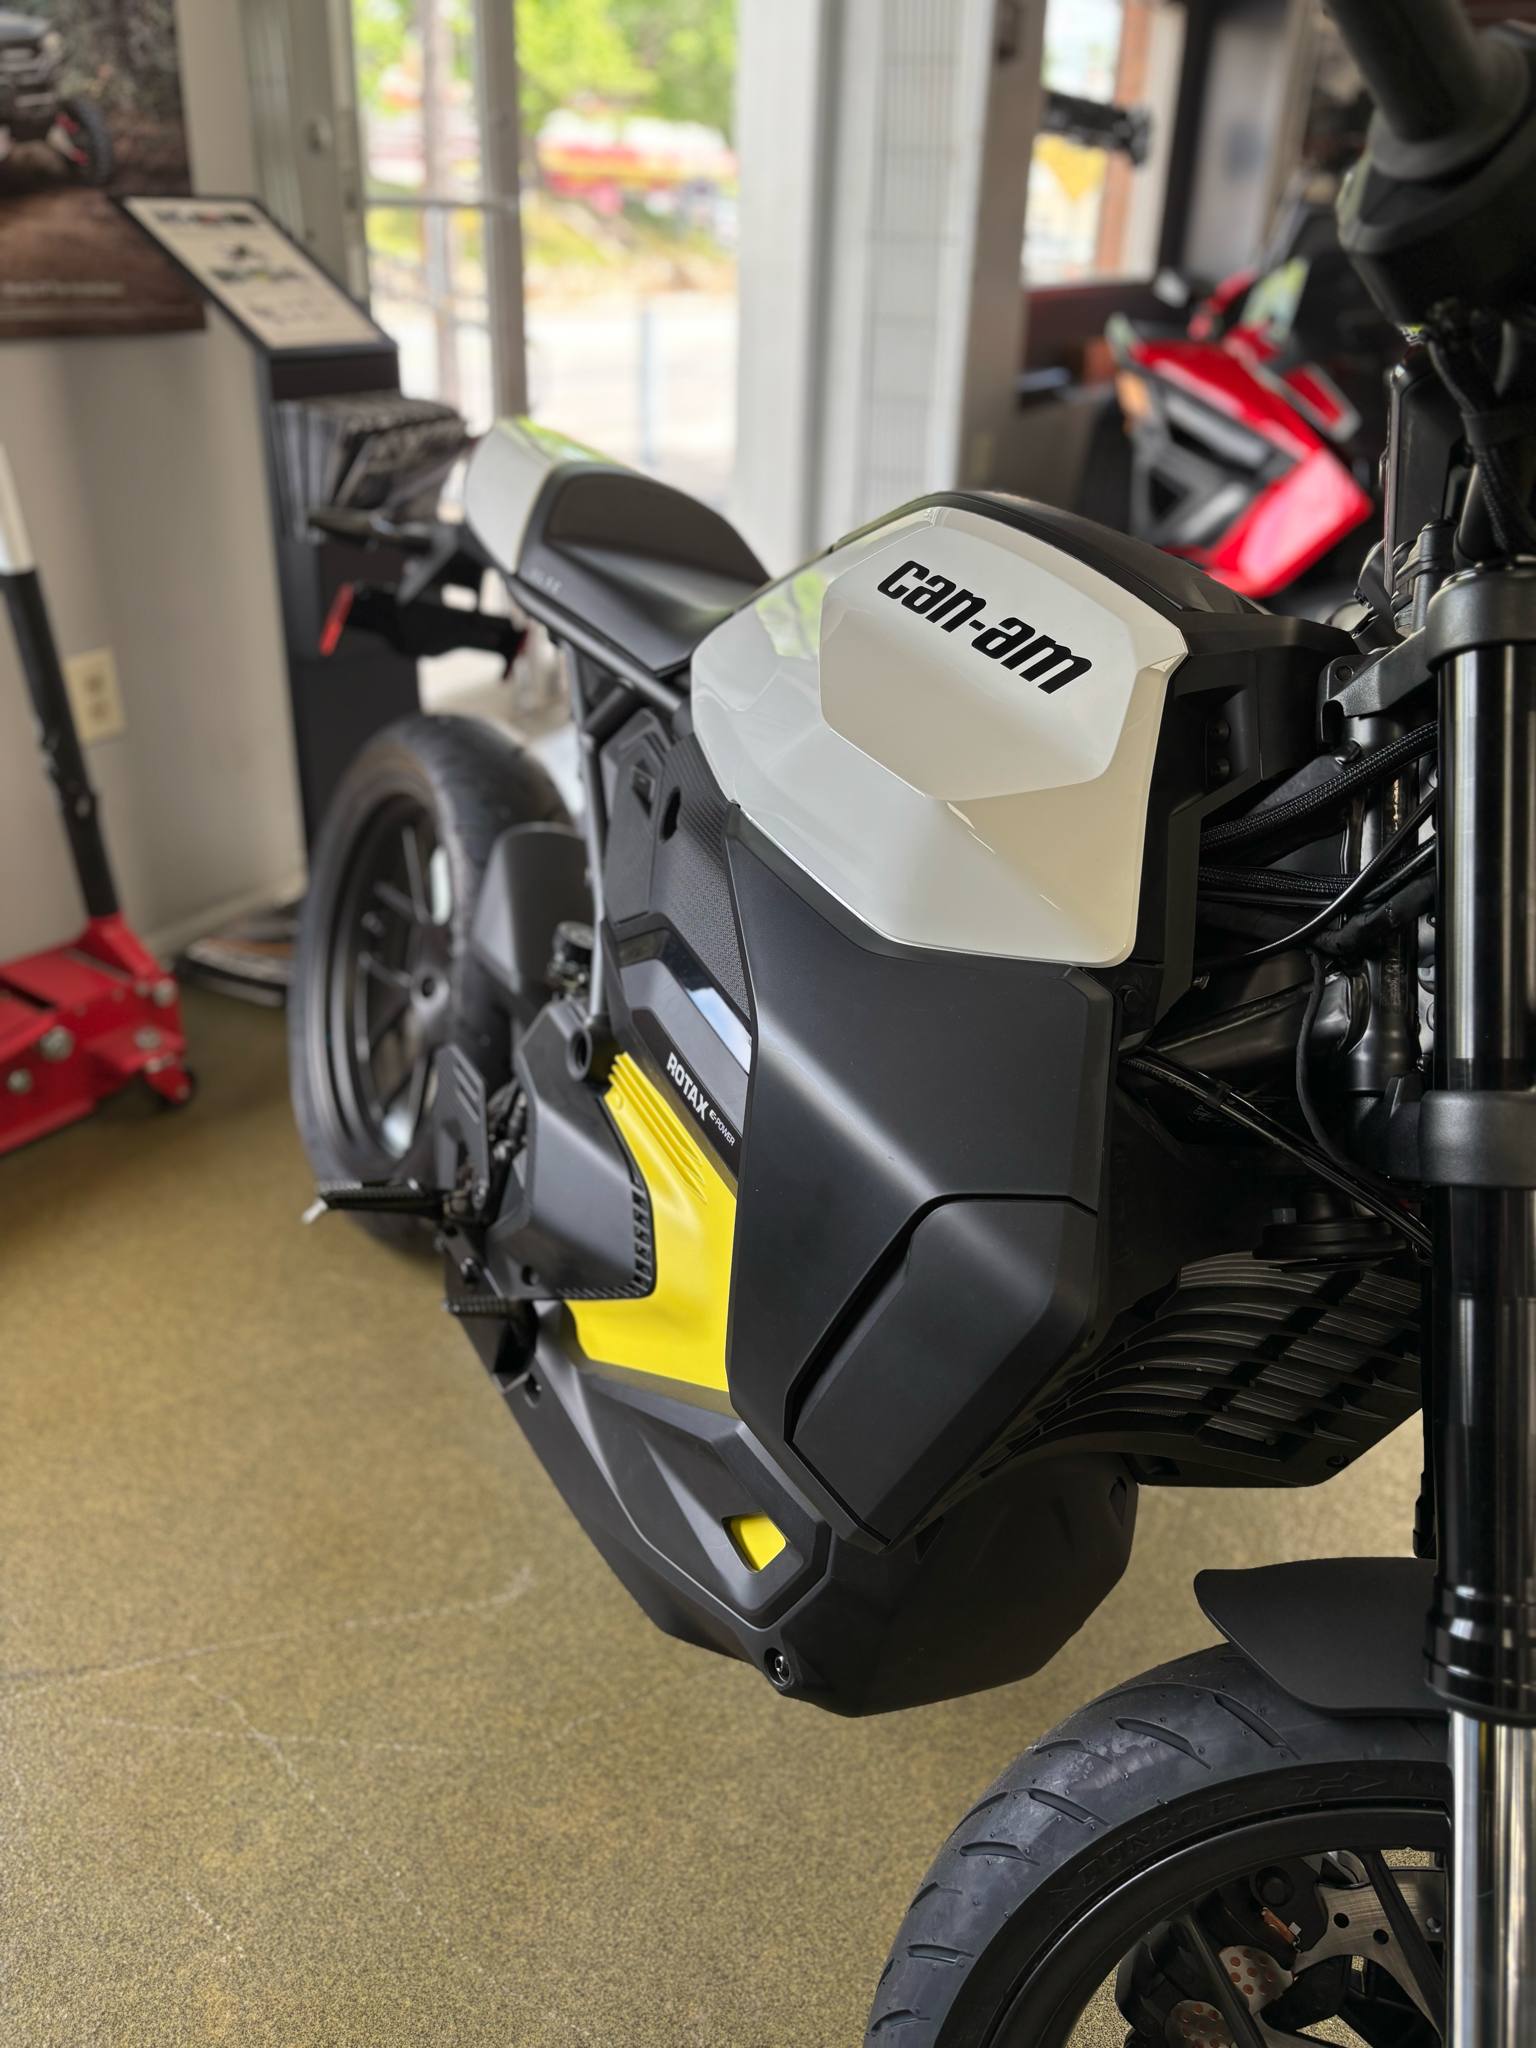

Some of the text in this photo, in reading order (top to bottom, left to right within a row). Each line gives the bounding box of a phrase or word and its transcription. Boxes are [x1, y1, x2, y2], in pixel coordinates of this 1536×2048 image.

[877, 560, 1093, 695] can-am
[666, 1052, 736, 1147] ROTAX E-POWER
